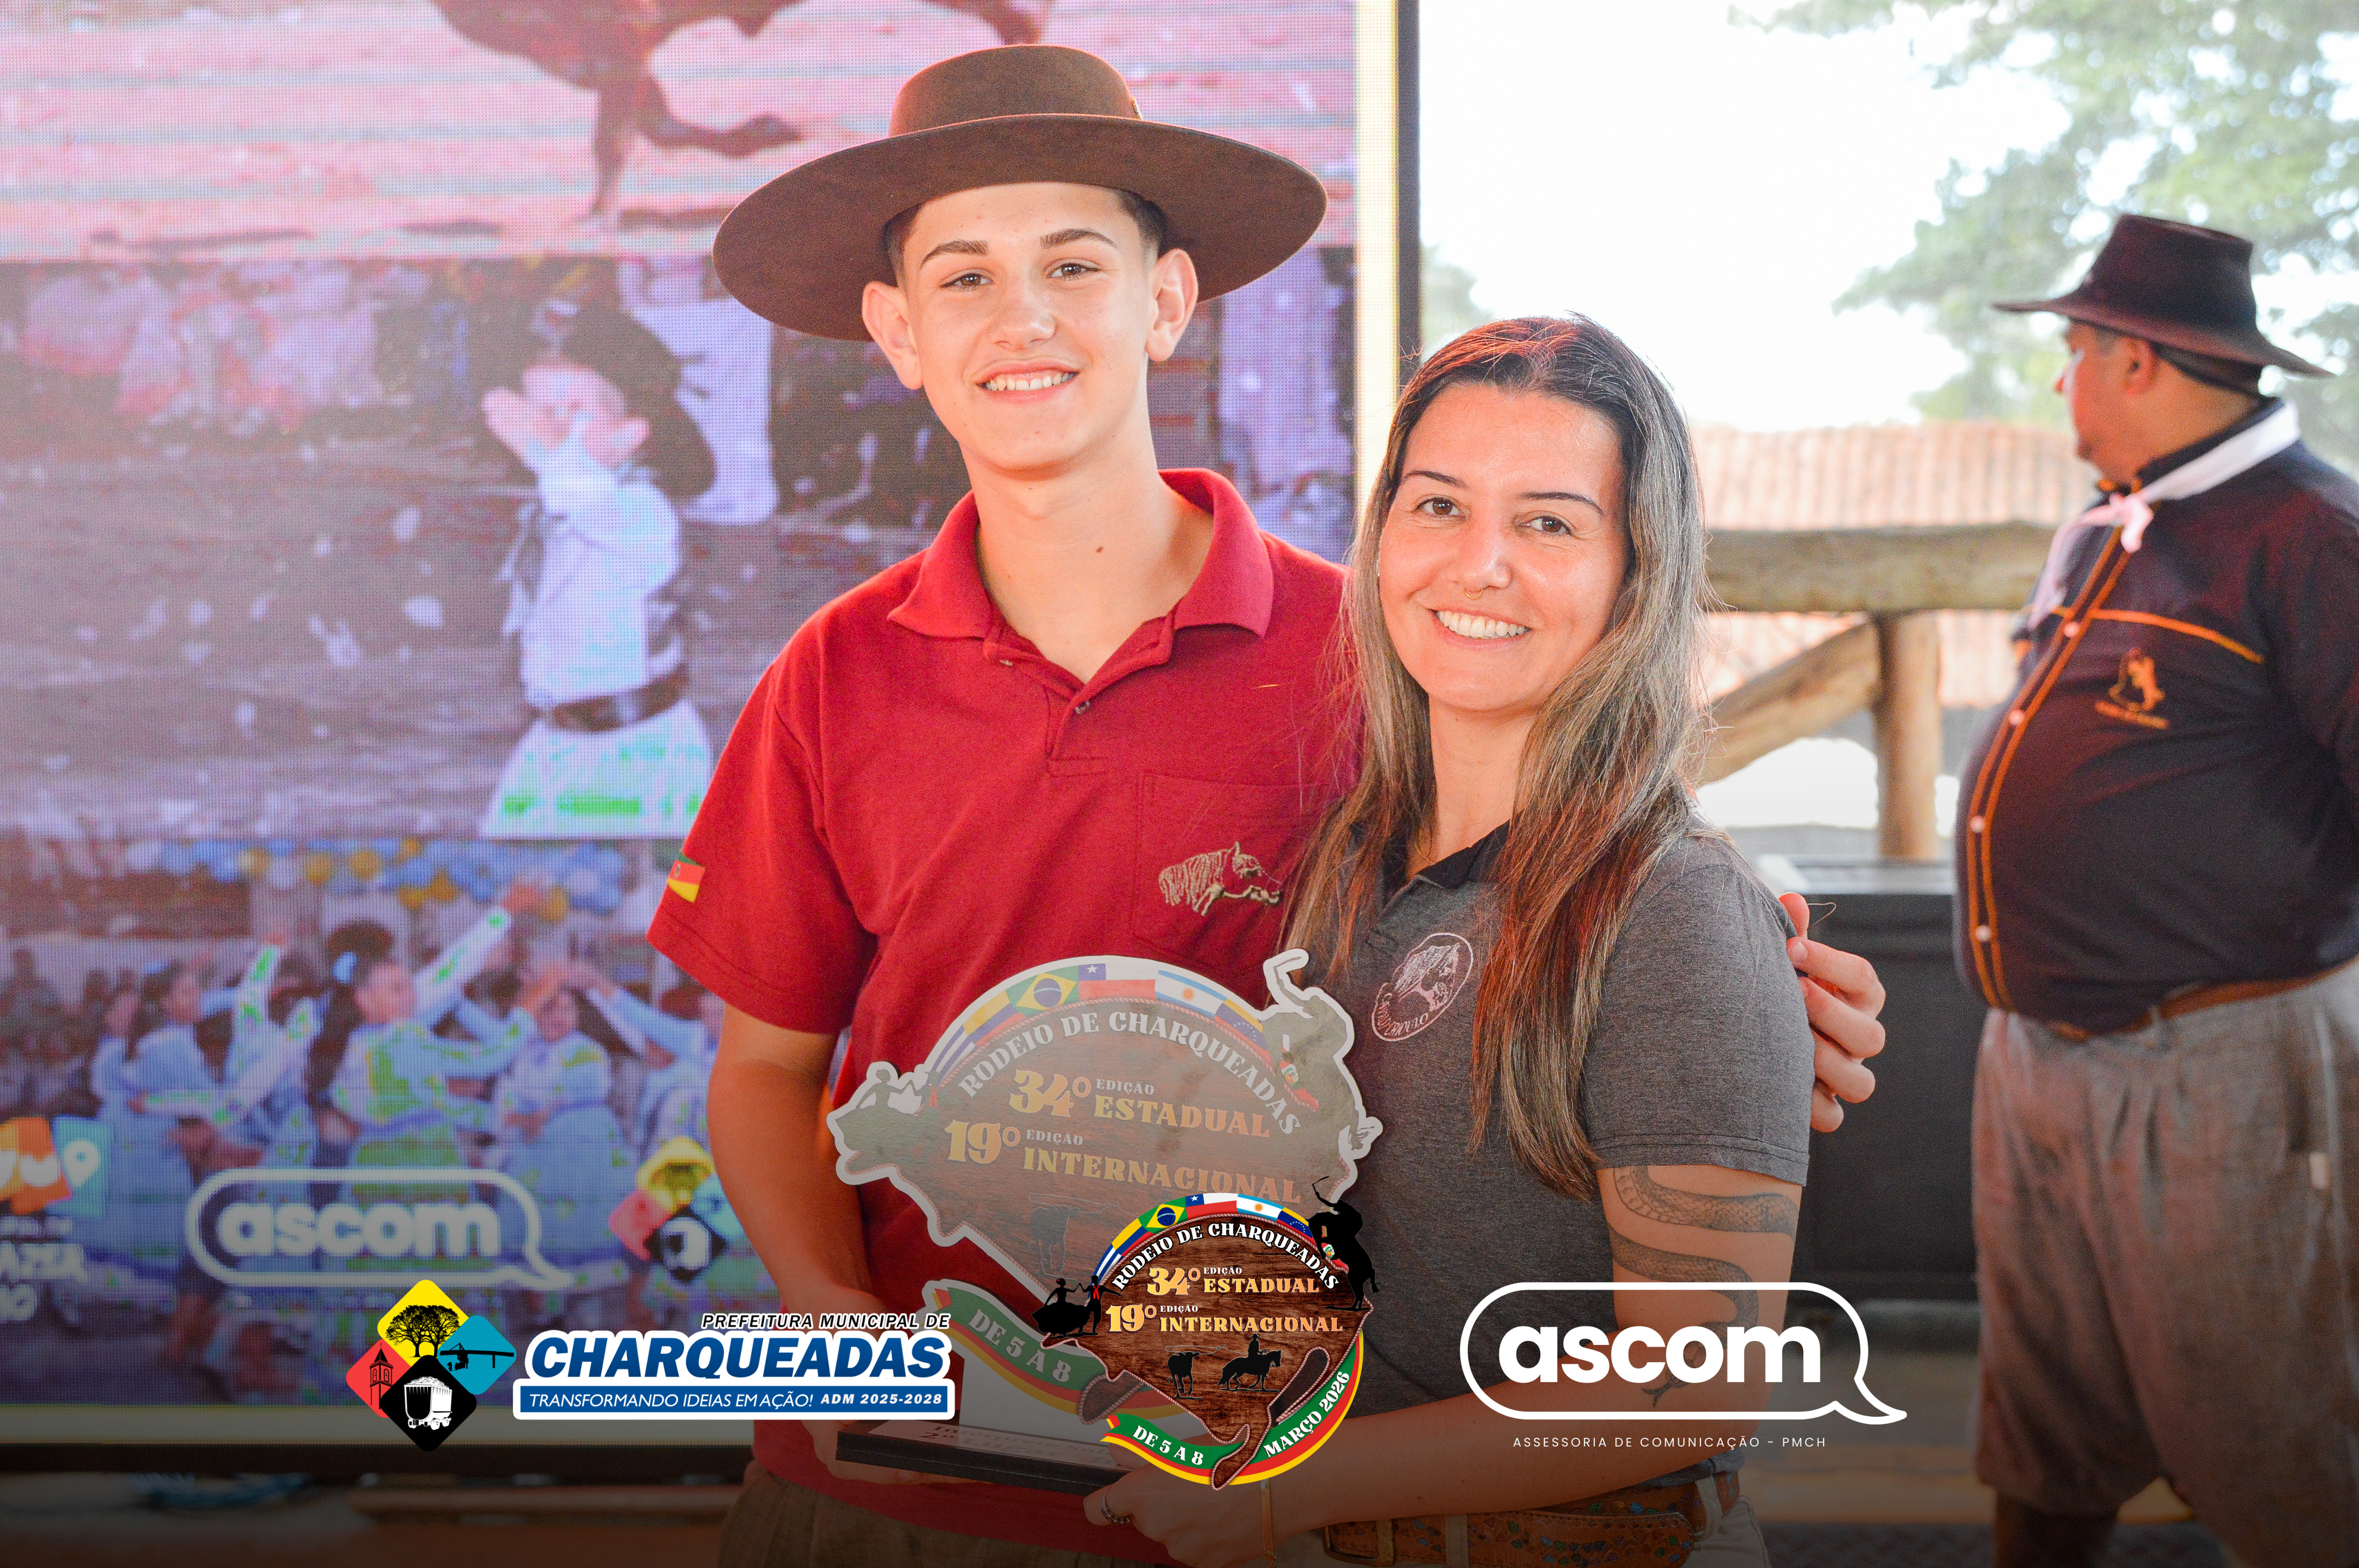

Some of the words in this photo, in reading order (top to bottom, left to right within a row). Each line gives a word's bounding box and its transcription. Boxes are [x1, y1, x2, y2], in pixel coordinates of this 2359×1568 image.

[958, 1024, 1054, 1098] RODEIO
[1060, 1012, 1100, 1037] DE
[1109, 1011, 1301, 1135] CHARQUEADAS
[1096, 1078, 1155, 1096] EDIÇÃO
[1026, 1129, 1083, 1146] EDIÇÃO
[1094, 1094, 1270, 1137] ESTADUAL
[1023, 1147, 1300, 1204] INTERNACIONAL
[216, 1203, 501, 1258] ascom
[968, 1308, 1007, 1346] DE
[1005, 1336, 1026, 1357] 5
[1025, 1349, 1045, 1373] A
[1052, 1359, 1071, 1383] 8
